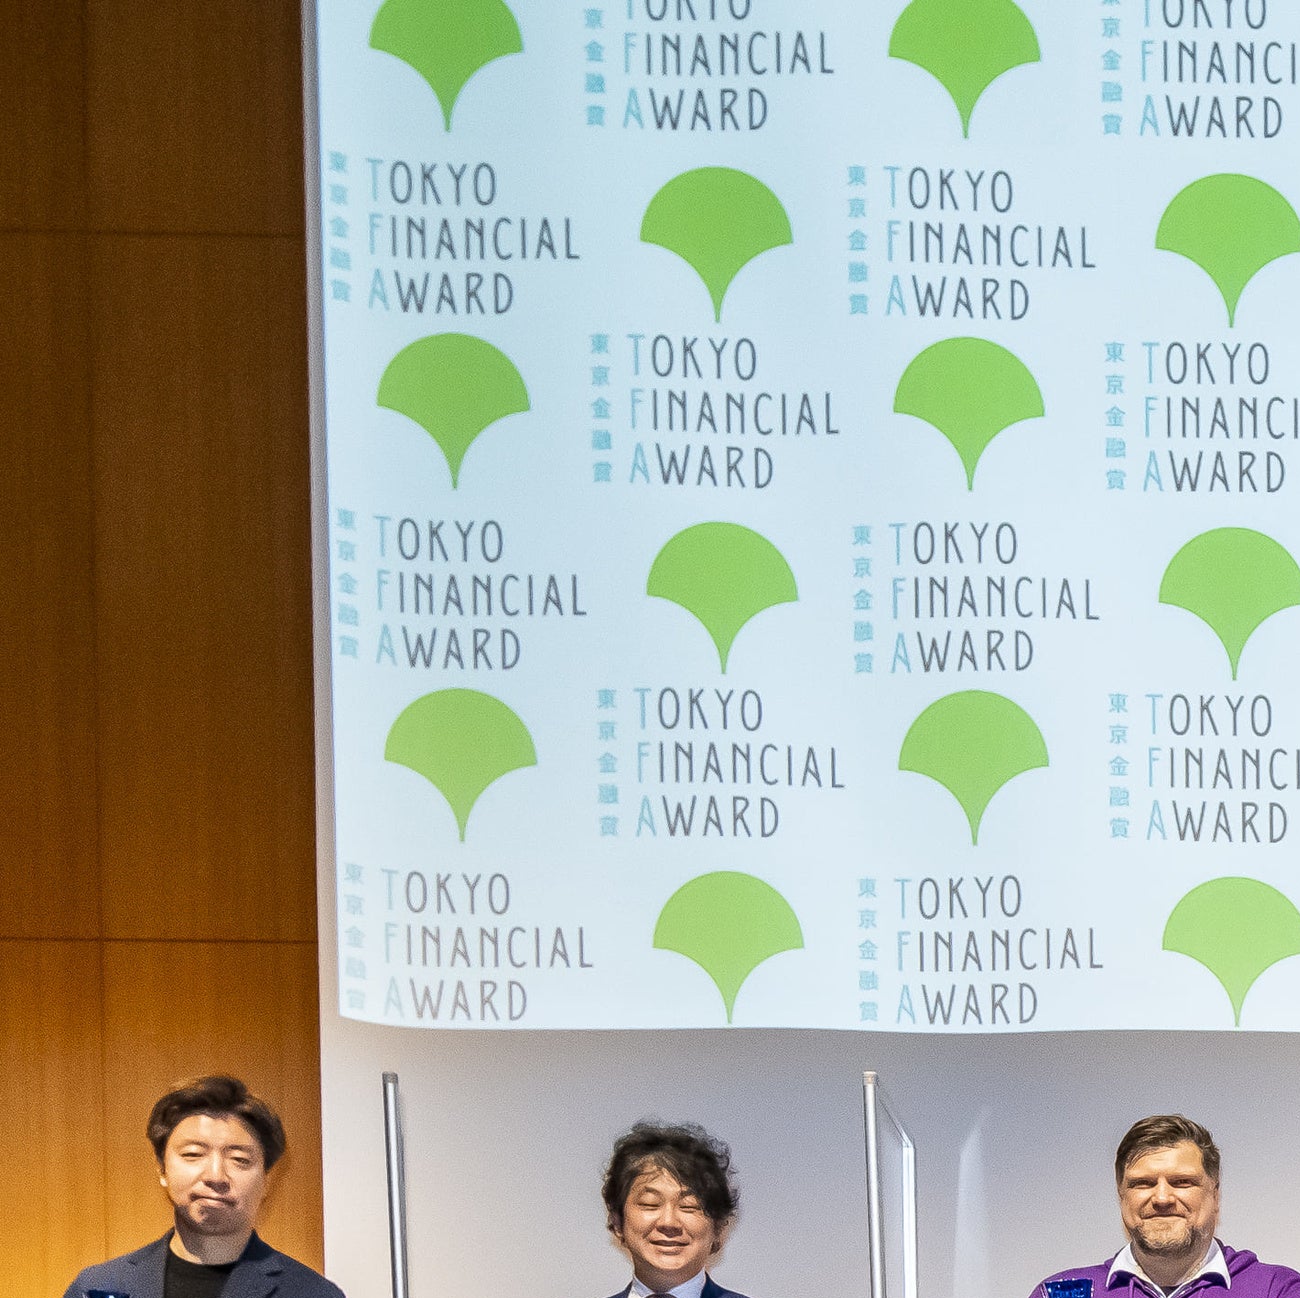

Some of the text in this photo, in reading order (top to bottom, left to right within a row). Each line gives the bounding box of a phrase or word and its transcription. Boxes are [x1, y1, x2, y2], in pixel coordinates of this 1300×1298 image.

[624, 30, 835, 77] FINANCIAL
[1101, 0, 1123, 135] 京金融賞
[622, 87, 769, 132] AWARD
[1139, 94, 1283, 139] AWARD
[365, 157, 497, 207] TOKYO
[883, 165, 1014, 214] TOKYO
[369, 212, 581, 261] FINANCIAL
[847, 165, 869, 315] 東京金融賞
[887, 219, 1097, 269] FINANCIAL
[368, 268, 514, 316] AWARD
[885, 274, 1030, 321] AWARD
[626, 333, 757, 382] TOKYO
[1141, 341, 1270, 385] TOKYO
[630, 388, 840, 436] FINANCIAL
[1104, 341, 1127, 490] 東京金融賞
[629, 442, 774, 489] AWARD
[1143, 449, 1286, 493] AWARD
[373, 515, 504, 563] TOKYO
[888, 521, 1018, 566] TOKYO
[377, 568, 587, 617] FINANCIAL
[852, 524, 874, 674] 東京金融賞
[892, 575, 1100, 621] FINANCIAL
[376, 624, 521, 671] AWARD
[890, 629, 1034, 674] AWARD
[633, 686, 763, 732] TOKYO
[1145, 693, 1272, 737] TOKYO
[637, 741, 845, 789] FINANCIAL
[1108, 692, 1130, 838] 東京金融賞
[636, 794, 779, 838] AWARD
[1146, 799, 1288, 844] AWARD
[381, 869, 510, 916] TOKYO
[894, 874, 1022, 920] TOKYO
[385, 922, 594, 969] FINANCIAL
[858, 877, 879, 1021] 東京金融賞
[897, 927, 1104, 973] FINANCIAL
[384, 976, 527, 1021] AWARD
[896, 982, 1038, 1025] AWARD
